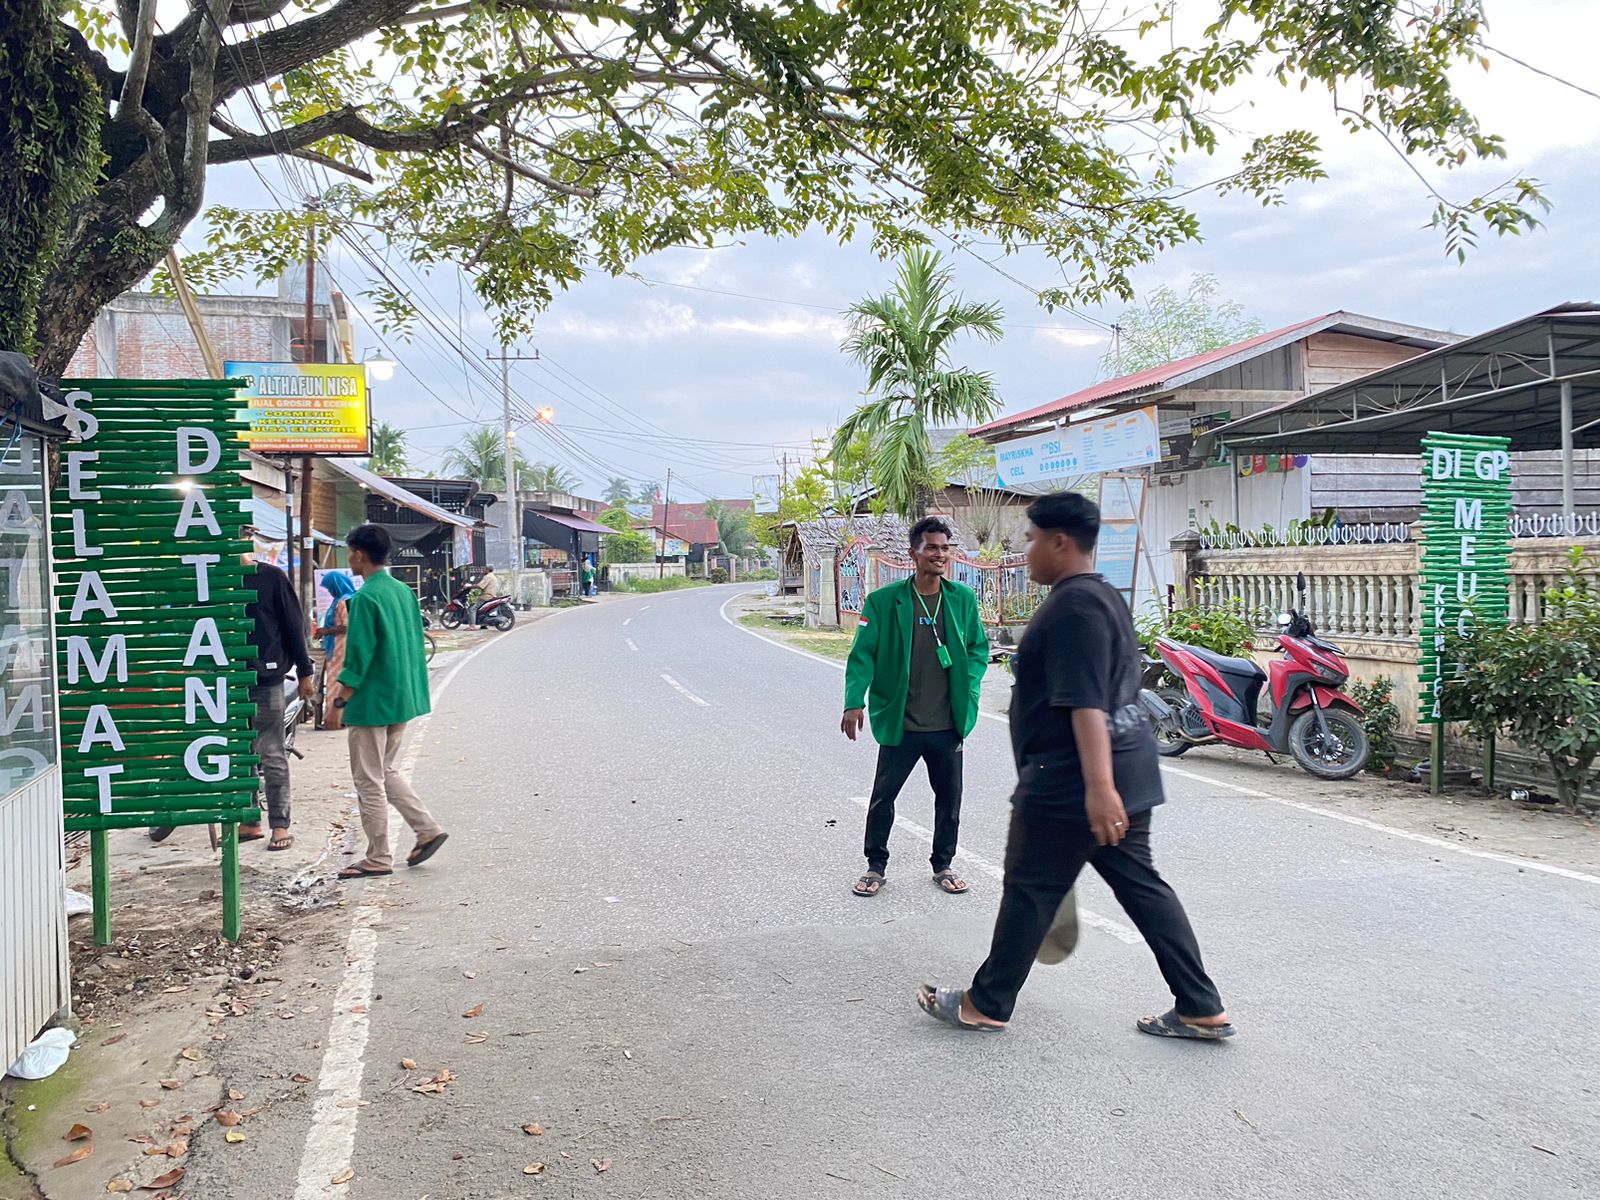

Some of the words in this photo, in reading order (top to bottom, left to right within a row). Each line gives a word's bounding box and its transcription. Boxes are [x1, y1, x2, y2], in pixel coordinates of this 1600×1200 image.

[258, 375, 323, 396] ALTHAFUN
[327, 376, 358, 397] NISA
[1048, 441, 1061, 455] BSI
[1010, 466, 1025, 477] CELL
[1432, 448, 1461, 481] DI
[1474, 450, 1509, 481] GP
[65, 390, 128, 814] SELAMAT
[173, 427, 230, 783] DATANG
